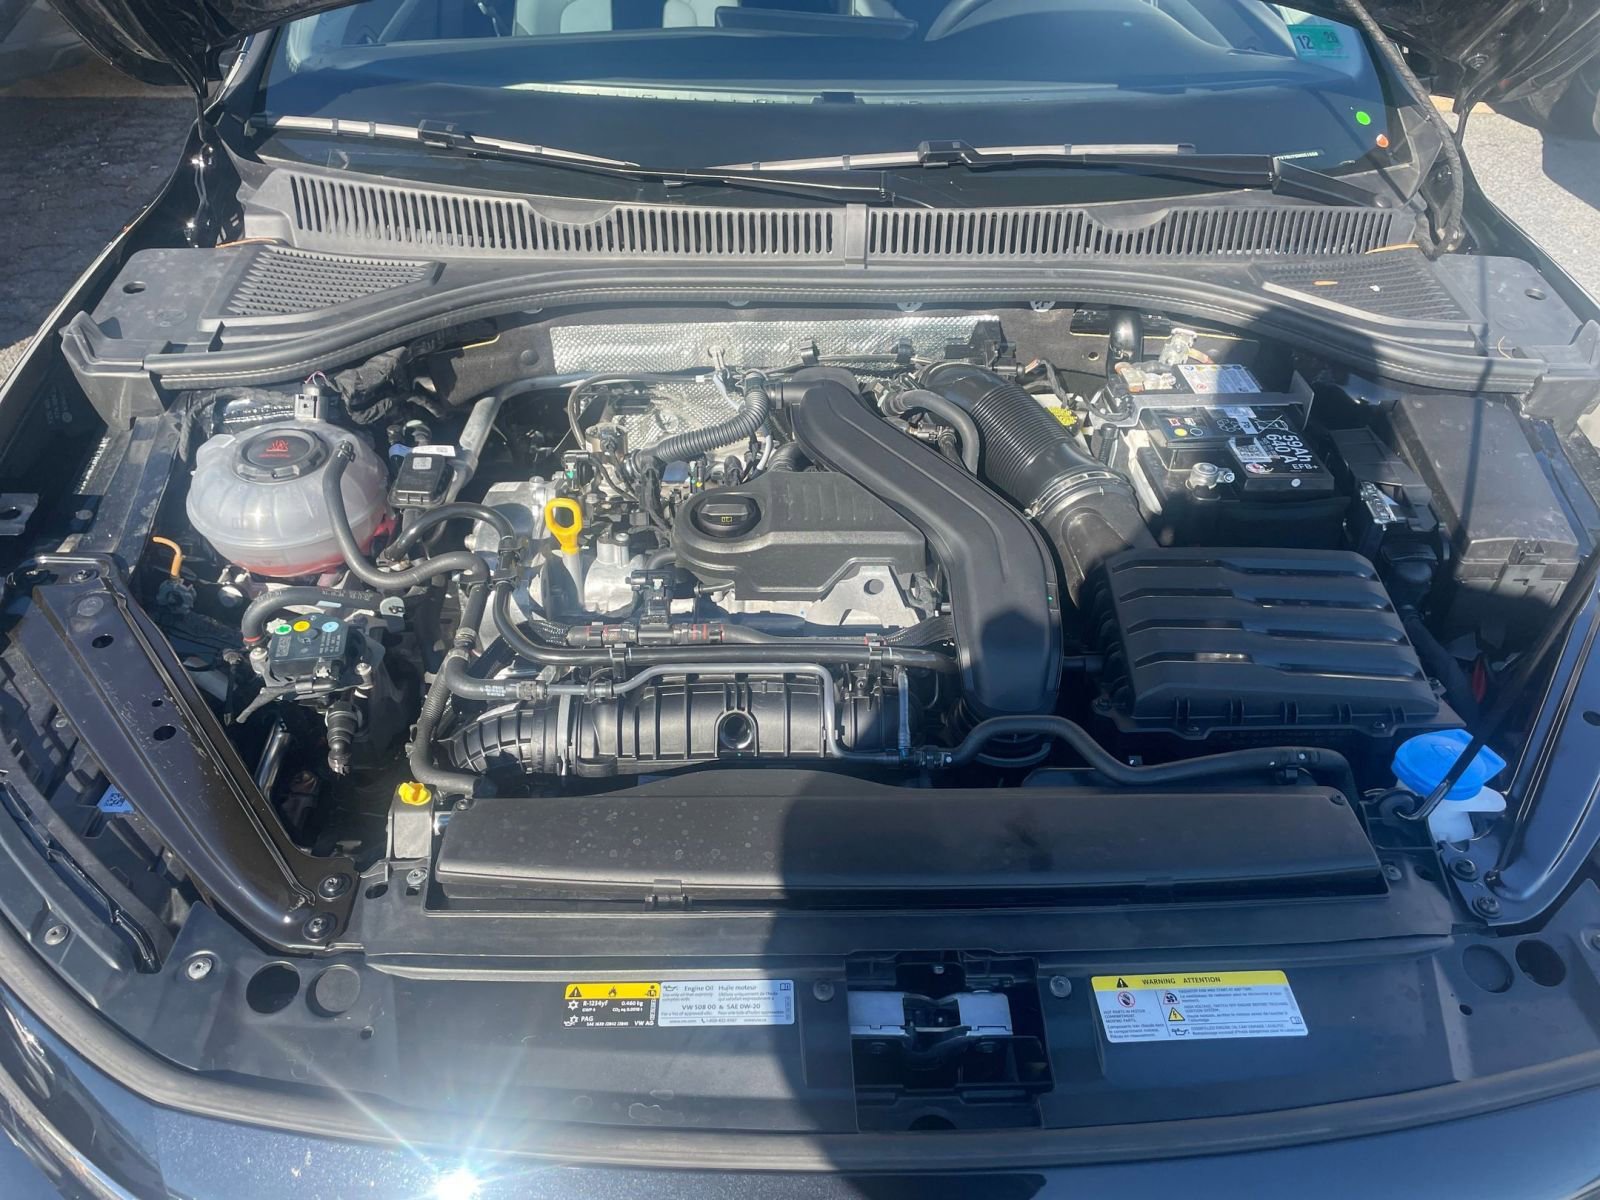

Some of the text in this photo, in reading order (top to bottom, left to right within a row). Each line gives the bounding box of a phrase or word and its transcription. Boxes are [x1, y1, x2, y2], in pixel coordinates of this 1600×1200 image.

[1296, 35, 1314, 50] 12
[1266, 433, 1292, 454] 640
[1282, 434, 1312, 462] 59Ah
[1291, 463, 1319, 471] EFB+
[1141, 976, 1221, 985] WARNING ATTENTION
[684, 984, 704, 993] Engine
[718, 984, 734, 992] Huile
[582, 1000, 608, 1008] R-1234yf
